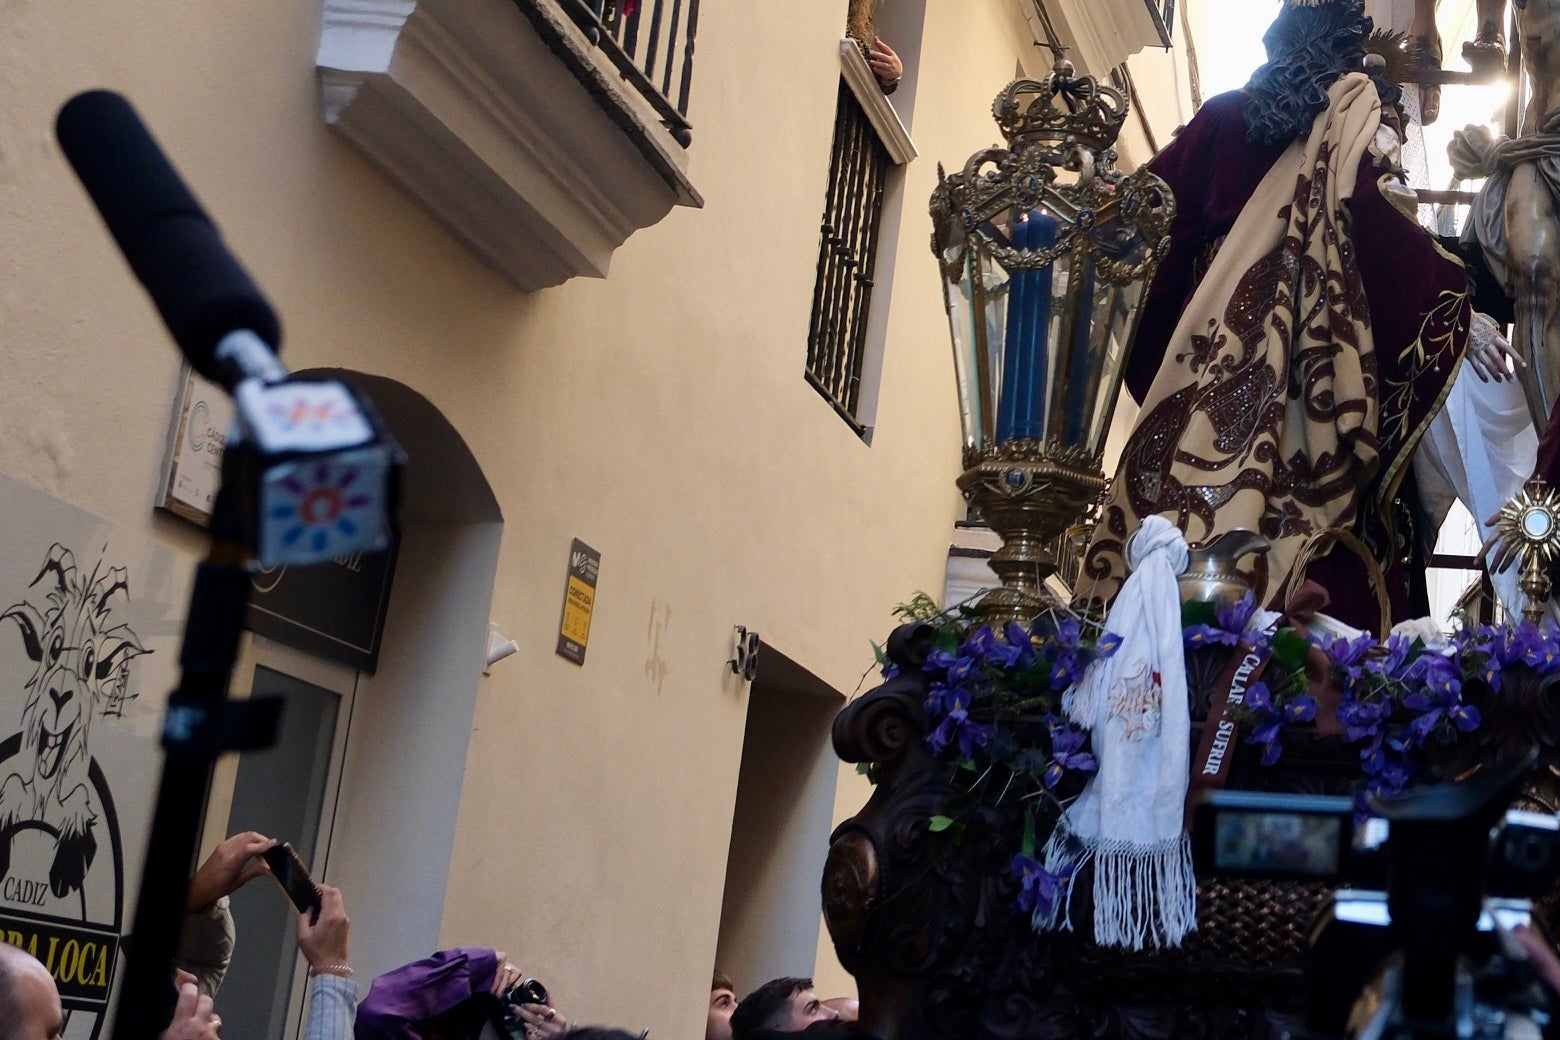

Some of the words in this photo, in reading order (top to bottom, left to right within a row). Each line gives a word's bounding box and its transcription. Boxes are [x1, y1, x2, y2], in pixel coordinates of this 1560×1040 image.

[1202, 720, 1235, 776] SUFRIR
[4, 876, 48, 907] CADIZ
[46, 936, 108, 987] LOCA
